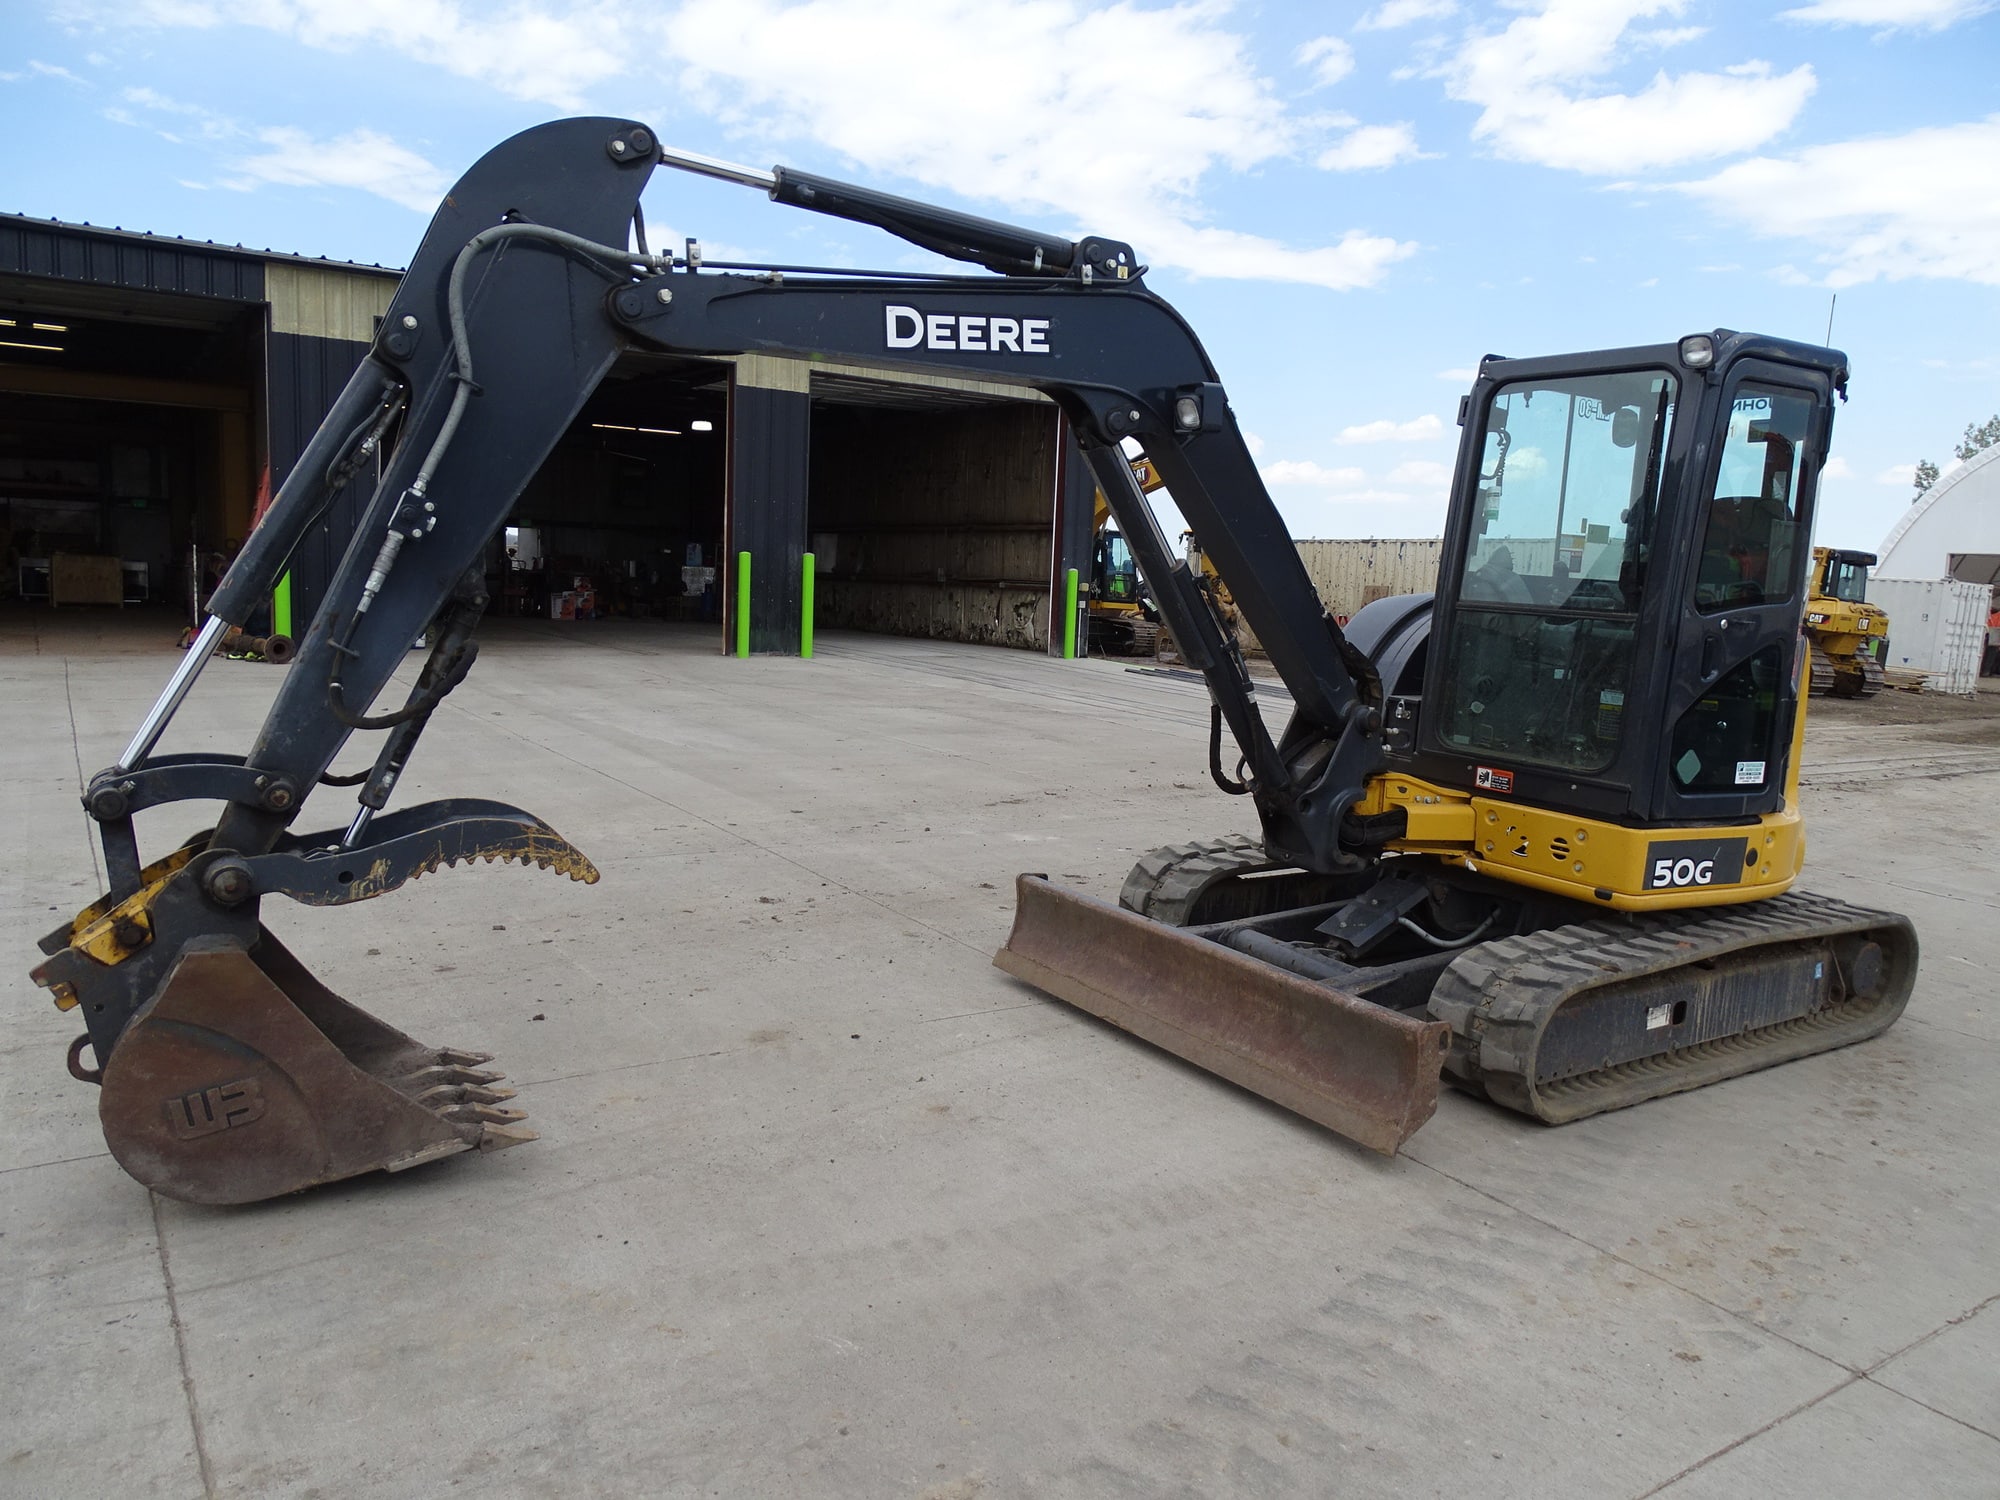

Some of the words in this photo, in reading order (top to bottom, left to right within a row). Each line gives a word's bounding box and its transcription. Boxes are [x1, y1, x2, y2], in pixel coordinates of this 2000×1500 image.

[885, 305, 1050, 352] DEERE
[1134, 467, 1146, 481] AT
[1809, 613, 1824, 623] CAT
[1652, 858, 1714, 887] 50G
